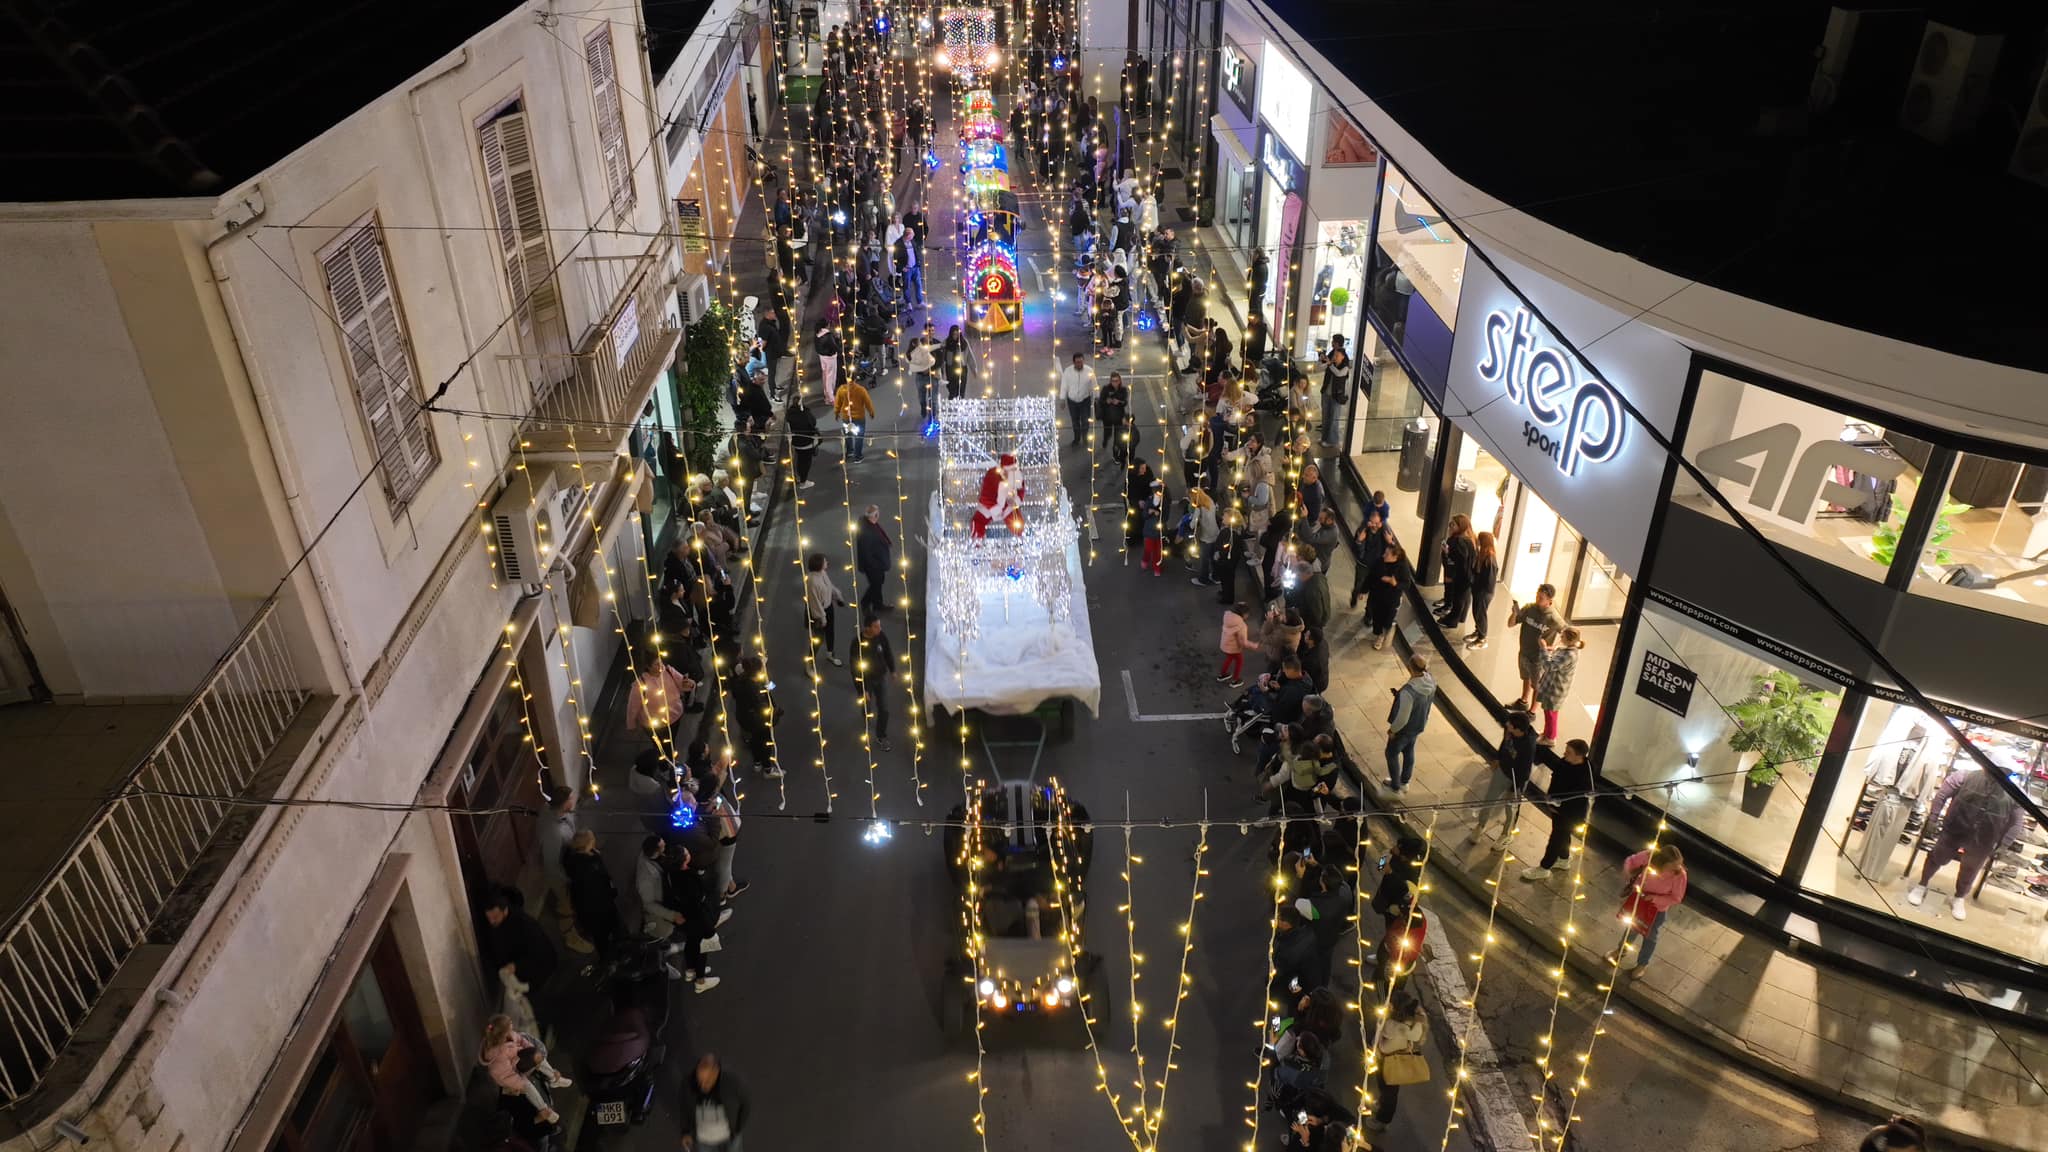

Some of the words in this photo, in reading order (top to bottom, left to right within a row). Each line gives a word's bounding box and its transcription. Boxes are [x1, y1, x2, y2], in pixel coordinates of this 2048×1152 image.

[1475, 305, 1625, 476] step
[1522, 419, 1561, 463] sport
[1649, 588, 1739, 635] www.stepsport.com
[1645, 663, 1692, 692] SEASON
[1646, 653, 1671, 671] MID
[1756, 636, 1856, 687] www.stepsport.com
[1642, 671, 1676, 694] SALES
[603, 1113, 623, 1122] 091
